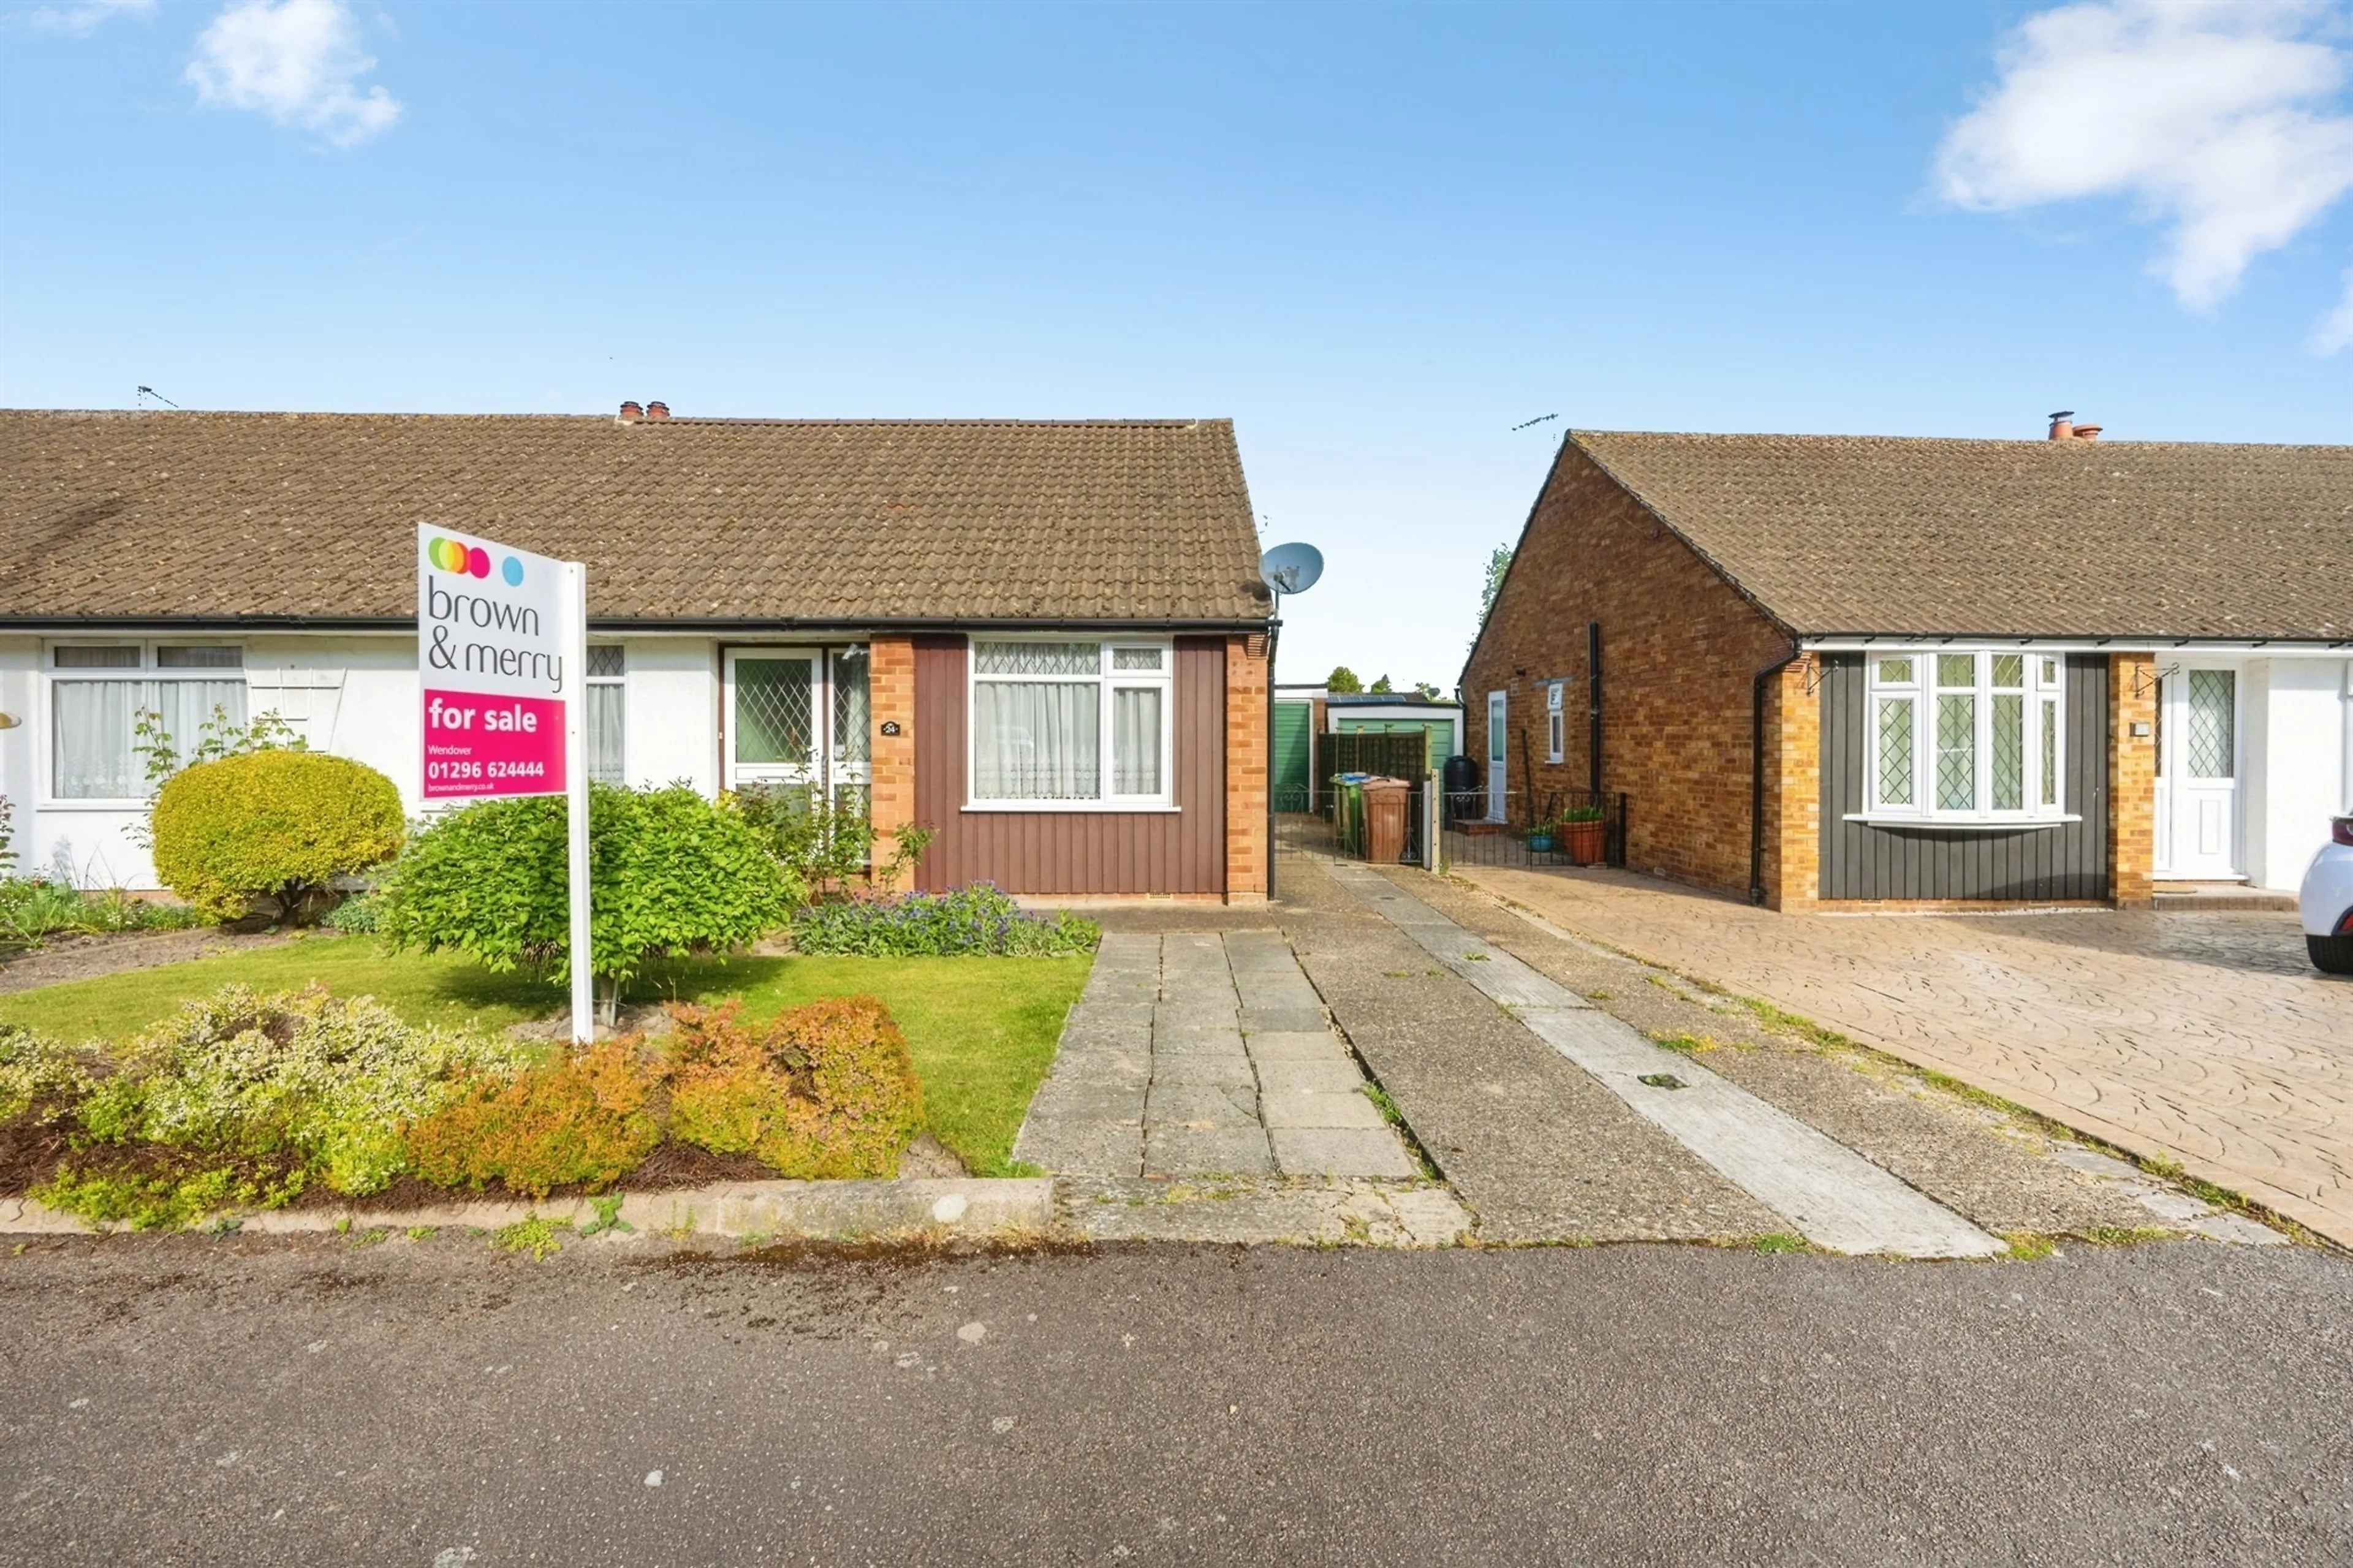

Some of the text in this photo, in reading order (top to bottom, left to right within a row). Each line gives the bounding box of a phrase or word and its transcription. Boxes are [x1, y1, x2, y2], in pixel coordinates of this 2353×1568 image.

[429, 575, 539, 636] brown
[429, 625, 562, 693] & merry
[428, 697, 537, 732] for sale
[428, 745, 472, 755] Wendover
[428, 761, 545, 779] 01296 624444
[428, 782, 494, 792] brownandmerry.co.uk
